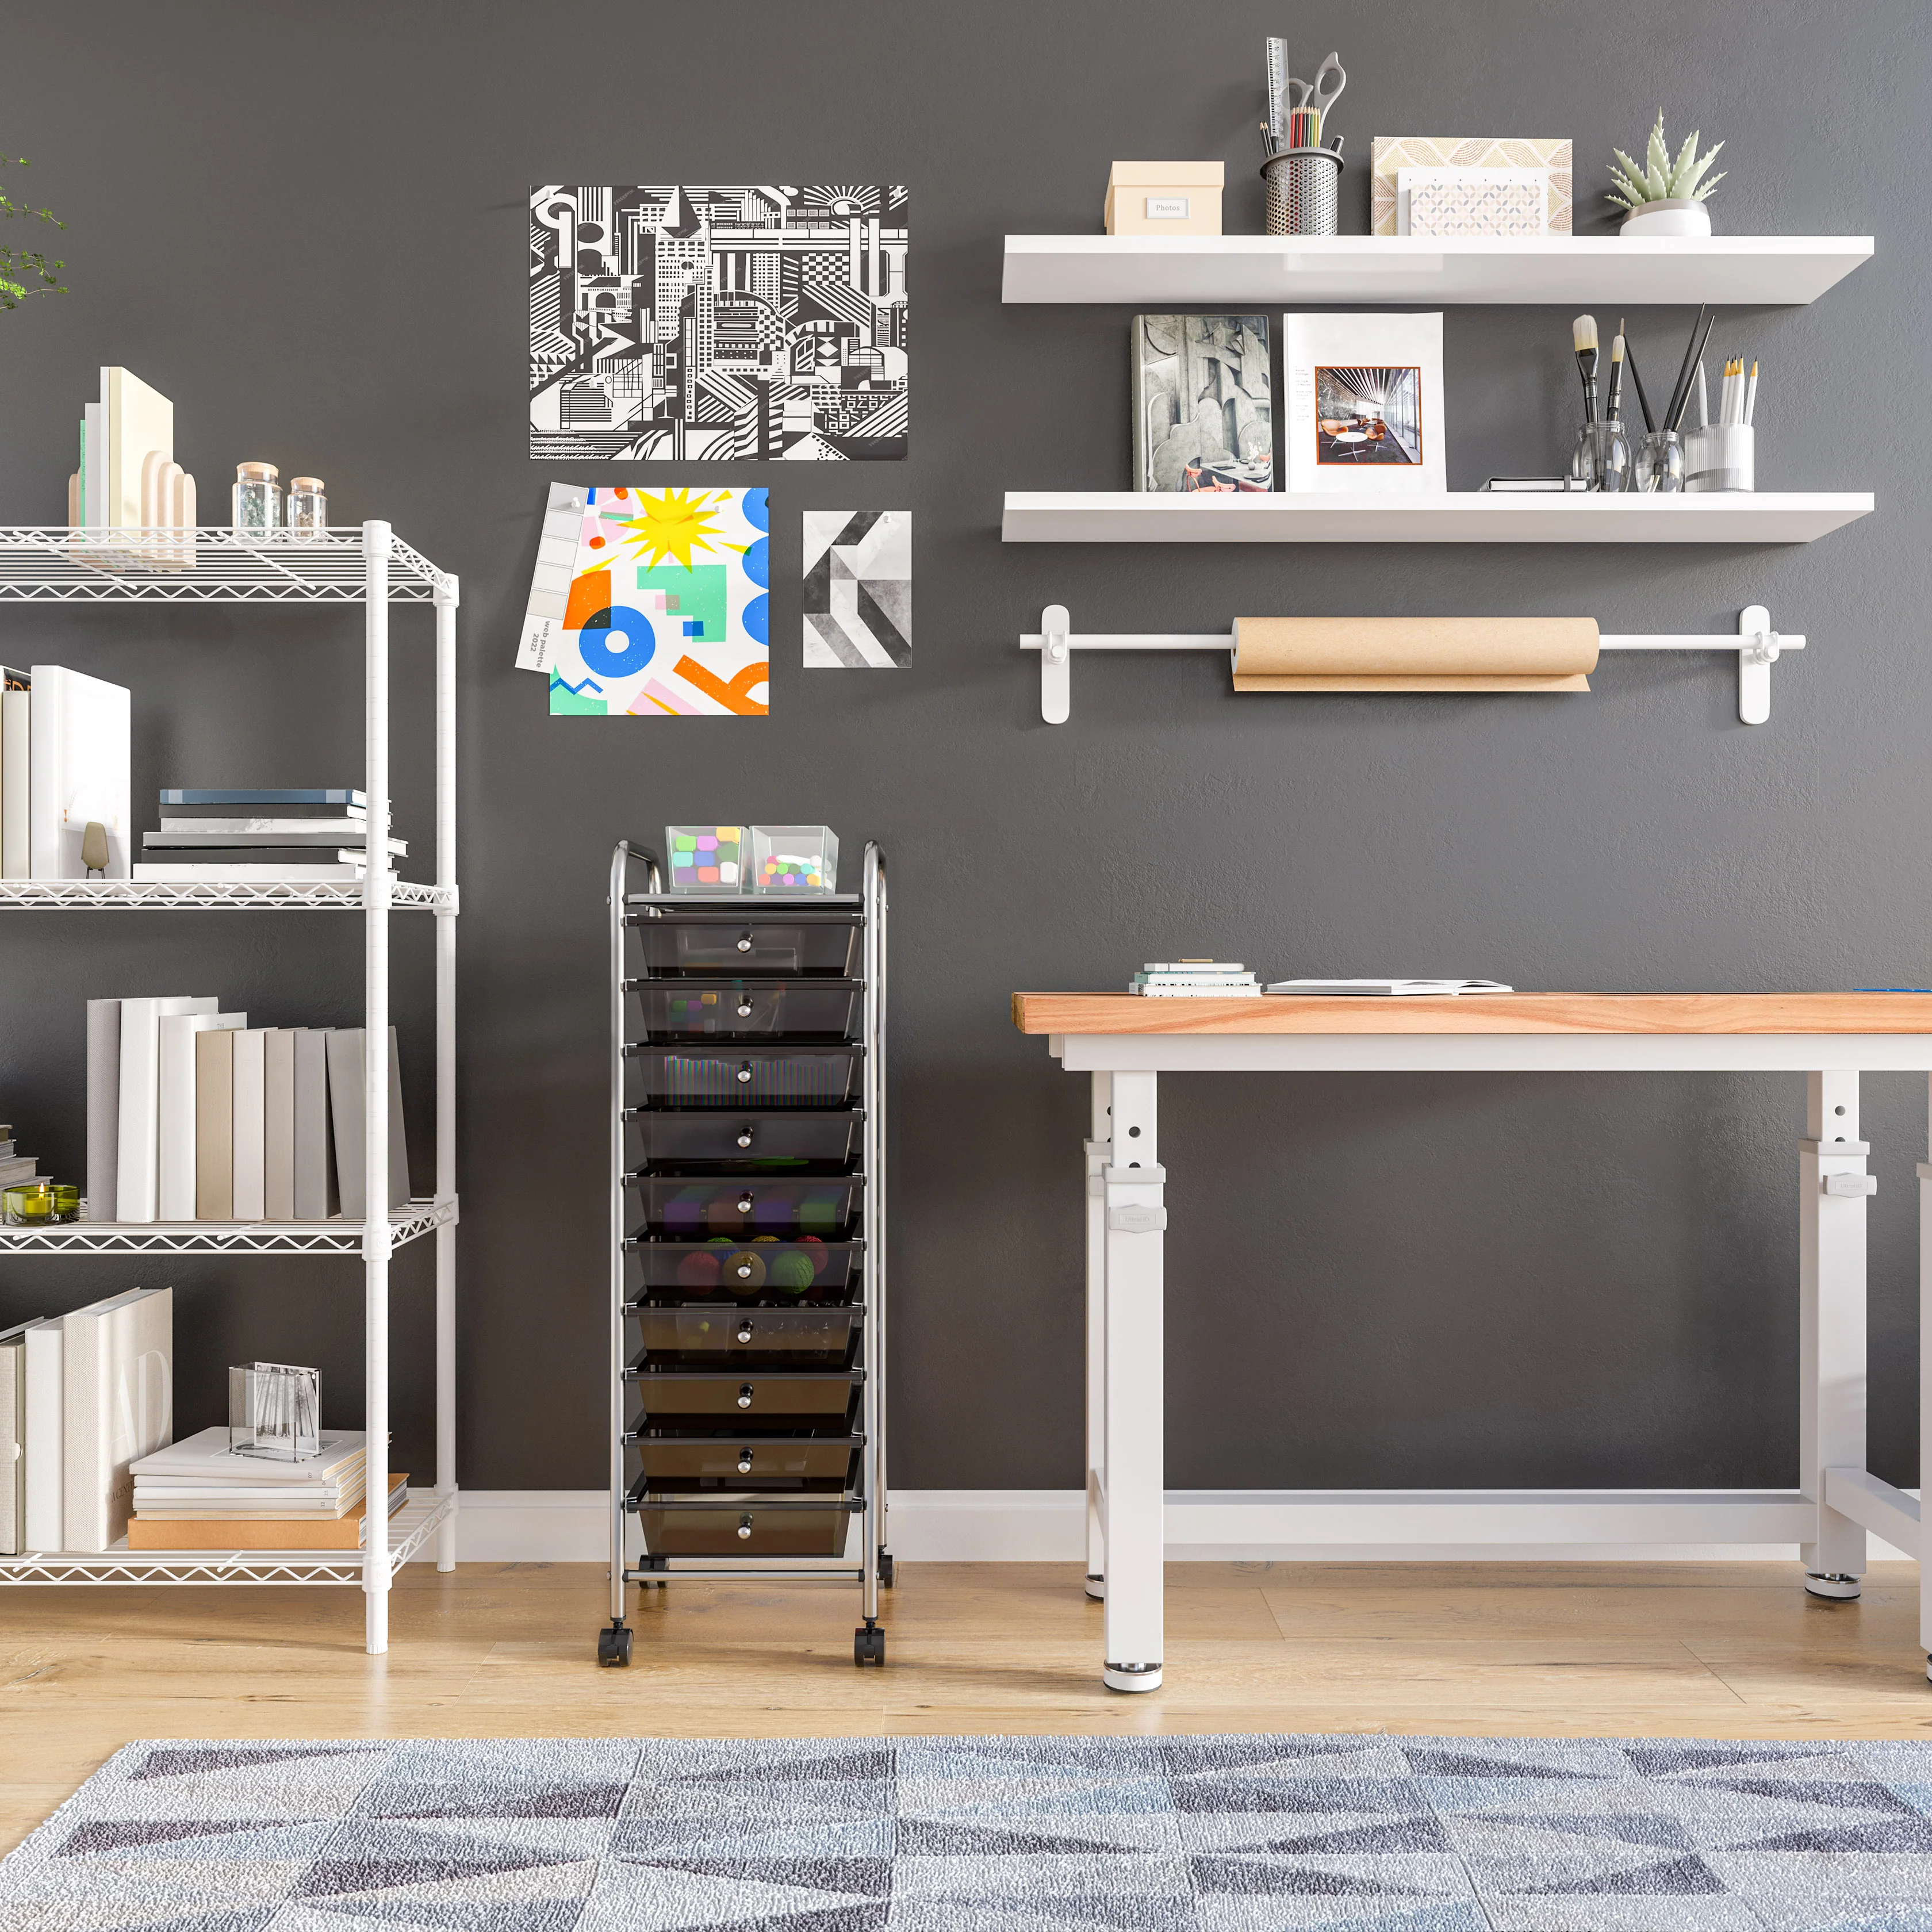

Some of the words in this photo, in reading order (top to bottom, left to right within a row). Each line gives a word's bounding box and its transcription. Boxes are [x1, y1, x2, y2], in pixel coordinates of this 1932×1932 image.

[614, 189, 635, 205] FREEPIK
[542, 620, 550, 638] web
[530, 633, 539, 652] 2022
[536, 639, 546, 668] palette
[103, 1350, 171, 1483] AD
